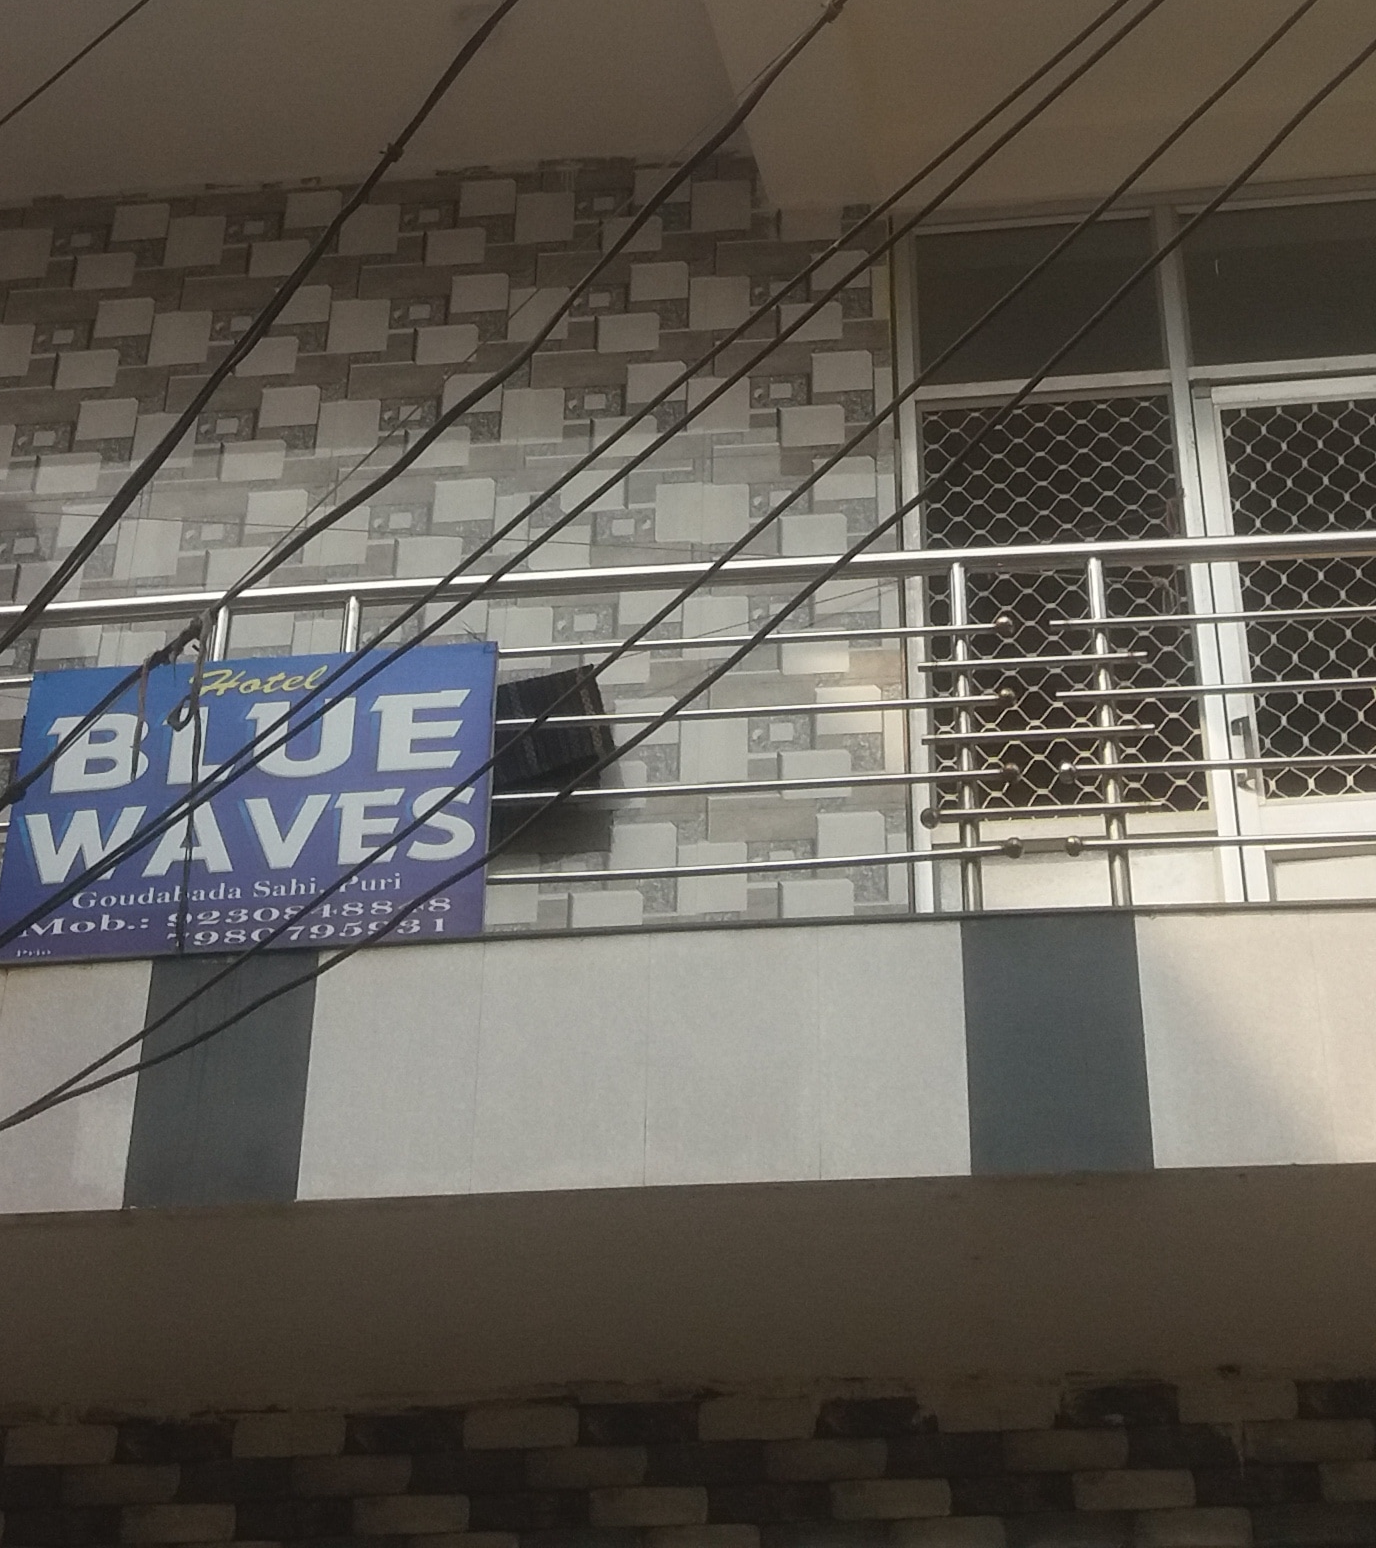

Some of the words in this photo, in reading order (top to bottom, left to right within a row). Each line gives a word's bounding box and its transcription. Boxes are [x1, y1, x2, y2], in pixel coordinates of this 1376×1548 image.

[189, 665, 328, 697] Hotel
[47, 689, 472, 794] BLUE
[25, 786, 477, 886] WAVES
[339, 872, 401, 893] Puri
